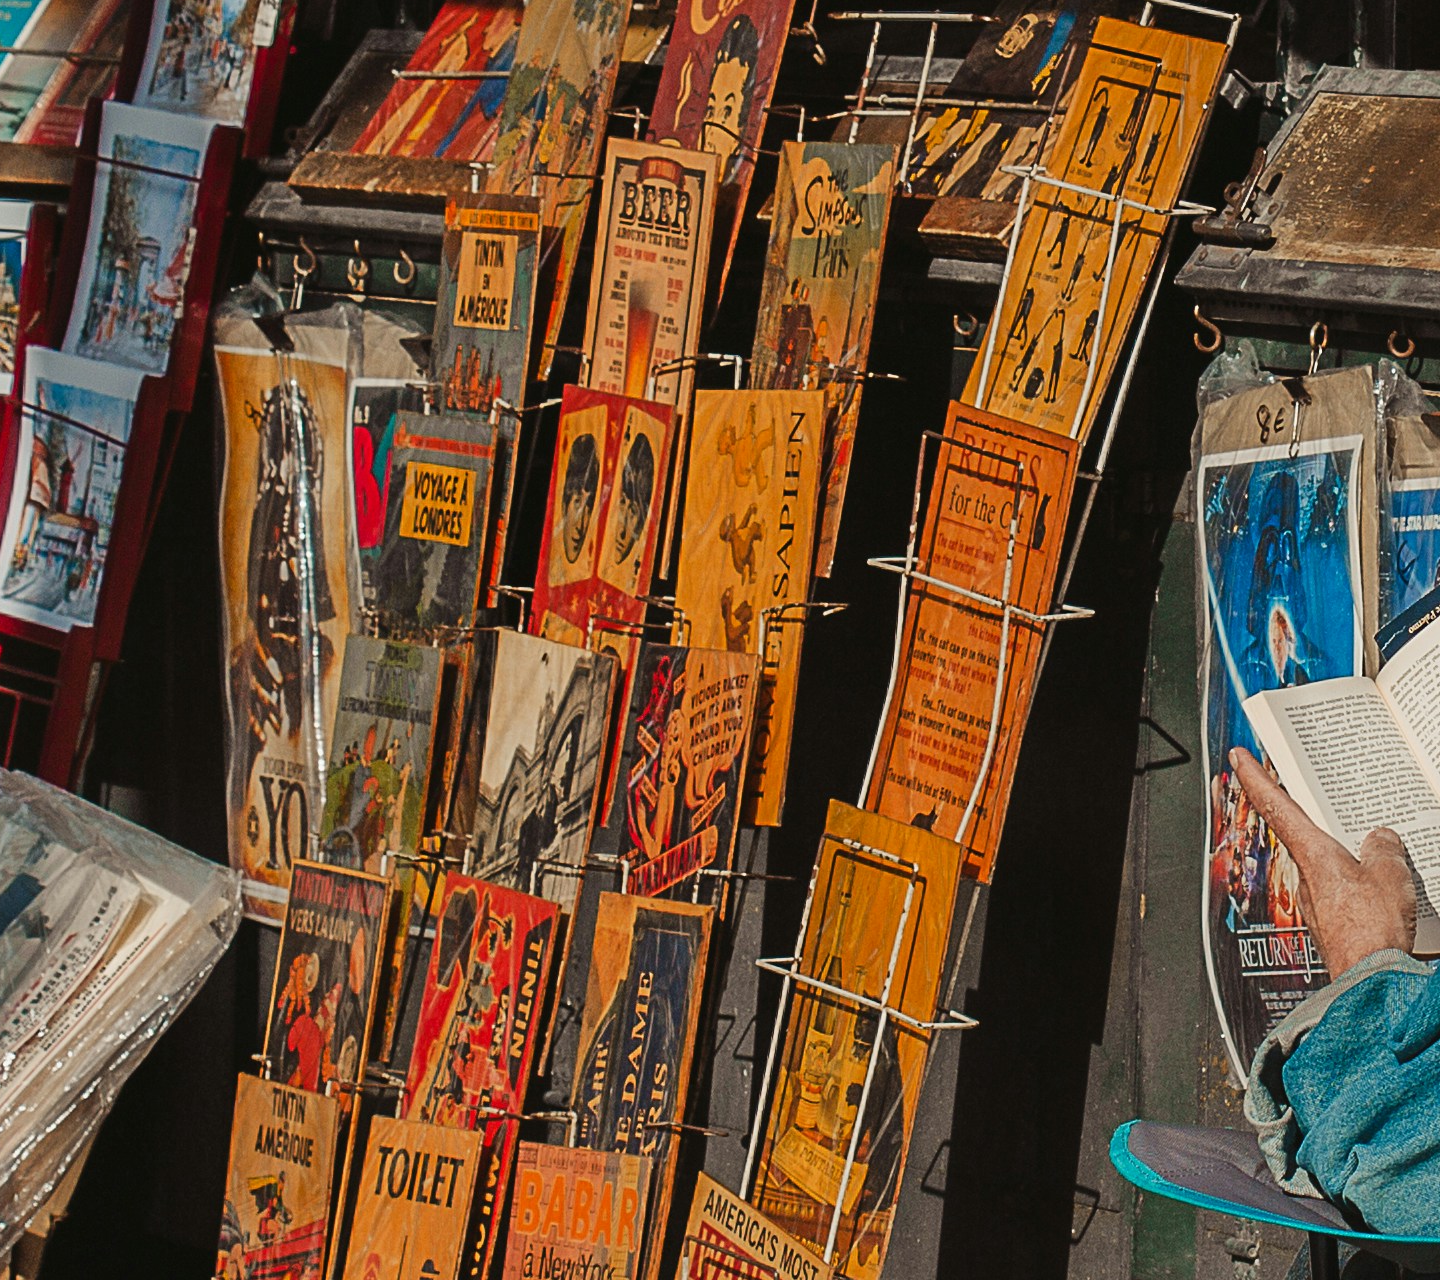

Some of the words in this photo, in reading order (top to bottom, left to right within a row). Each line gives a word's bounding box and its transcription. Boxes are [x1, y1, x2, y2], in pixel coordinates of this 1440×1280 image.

[828, 169, 848, 193] THE
[619, 182, 690, 231] BEER
[802, 176, 867, 235] SIMPSONS
[474, 239, 504, 268] TINTIN
[616, 228, 645, 243] AROUND
[649, 231, 663, 245] THE
[665, 235, 688, 250] WORLD
[458, 294, 508, 325] AMÉRIQUE
[960, 433, 1041, 498] RULES
[412, 468, 457, 503] VOYAGE
[411, 497, 463, 533] LONDRES
[772, 411, 806, 601] SAPIEN
[949, 484, 971, 515] for
[974, 494, 995, 523] the
[1000, 502, 1024, 533] Ct
[1406, 516, 1422, 531] STAR
[949, 537, 958, 550] cat
[1405, 609, 1437, 635] Palermo
[928, 634, 938, 647] the
[938, 638, 949, 651] cat
[949, 643, 960, 654] can
[961, 647, 968, 658] go
[969, 651, 976, 659] on
[977, 651, 986, 663] the
[699, 663, 704, 679] A
[691, 681, 721, 709] VICIOUS
[723, 675, 748, 692] RACKET
[690, 713, 706, 729] WITH
[708, 702, 720, 721] IT'S
[721, 695, 742, 712] ARMS
[946, 722, 951, 735] it
[947, 707, 957, 718] cat
[957, 711, 967, 722] can
[969, 715, 975, 727] go
[690, 722, 720, 747] AROUND
[723, 716, 742, 733] YOUR
[897, 774, 906, 786] cat
[906, 777, 917, 791] will
[917, 784, 923, 795] be
[924, 782, 933, 796] fed
[932, 787, 939, 798] at
[294, 869, 334, 905] TINTIN
[291, 908, 314, 934] VERS
[315, 914, 327, 938] LA
[1238, 938, 1294, 967] RETURN
[1302, 936, 1323, 983] JE
[510, 938, 543, 1059] TINTIN
[617, 970, 656, 1104] DAME
[272, 1087, 305, 1117] TINTIN
[639, 1061, 670, 1157] ARIS
[634, 1108, 646, 1138] DE
[254, 1131, 314, 1168] AMÉRIQUE
[374, 1147, 464, 1209] TOILET
[515, 1168, 639, 1252] BABAR
[703, 1189, 778, 1263] AMERICA'S
[523, 1251, 534, 1277] à
